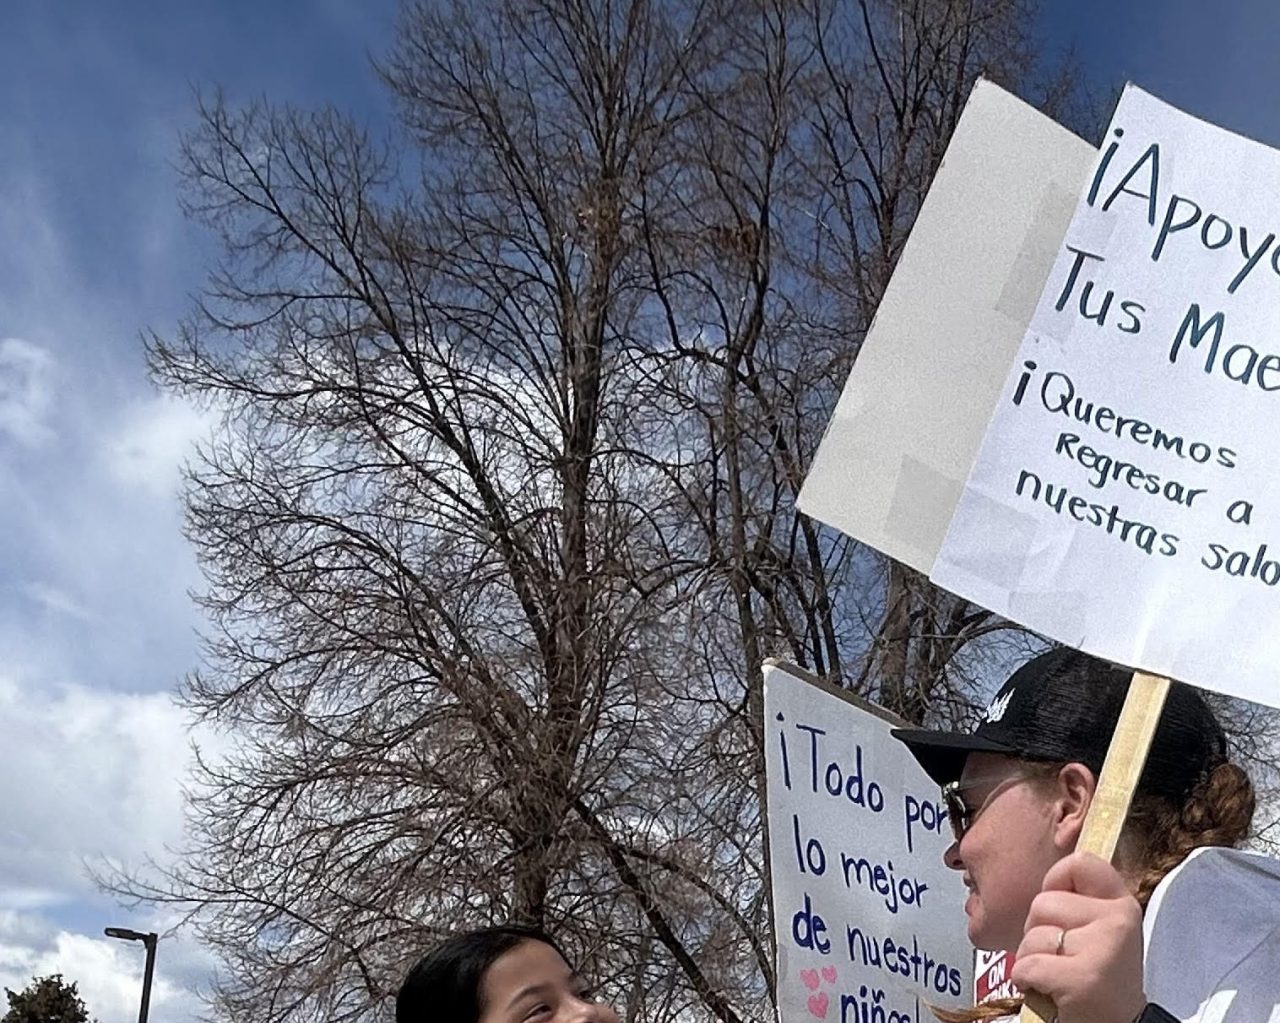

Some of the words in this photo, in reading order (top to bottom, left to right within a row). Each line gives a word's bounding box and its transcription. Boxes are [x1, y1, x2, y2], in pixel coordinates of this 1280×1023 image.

[1055, 245, 1147, 335] Tus
[1015, 468, 1181, 558] nuestras
[1055, 432, 1209, 508] Regresar
[1226, 499, 1254, 526] a
[793, 814, 827, 877] lo
[841, 852, 929, 914] mejor
[905, 794, 948, 853] por
[791, 893, 832, 955] de
[847, 922, 962, 997] nuestros
[988, 958, 1007, 990] ON
